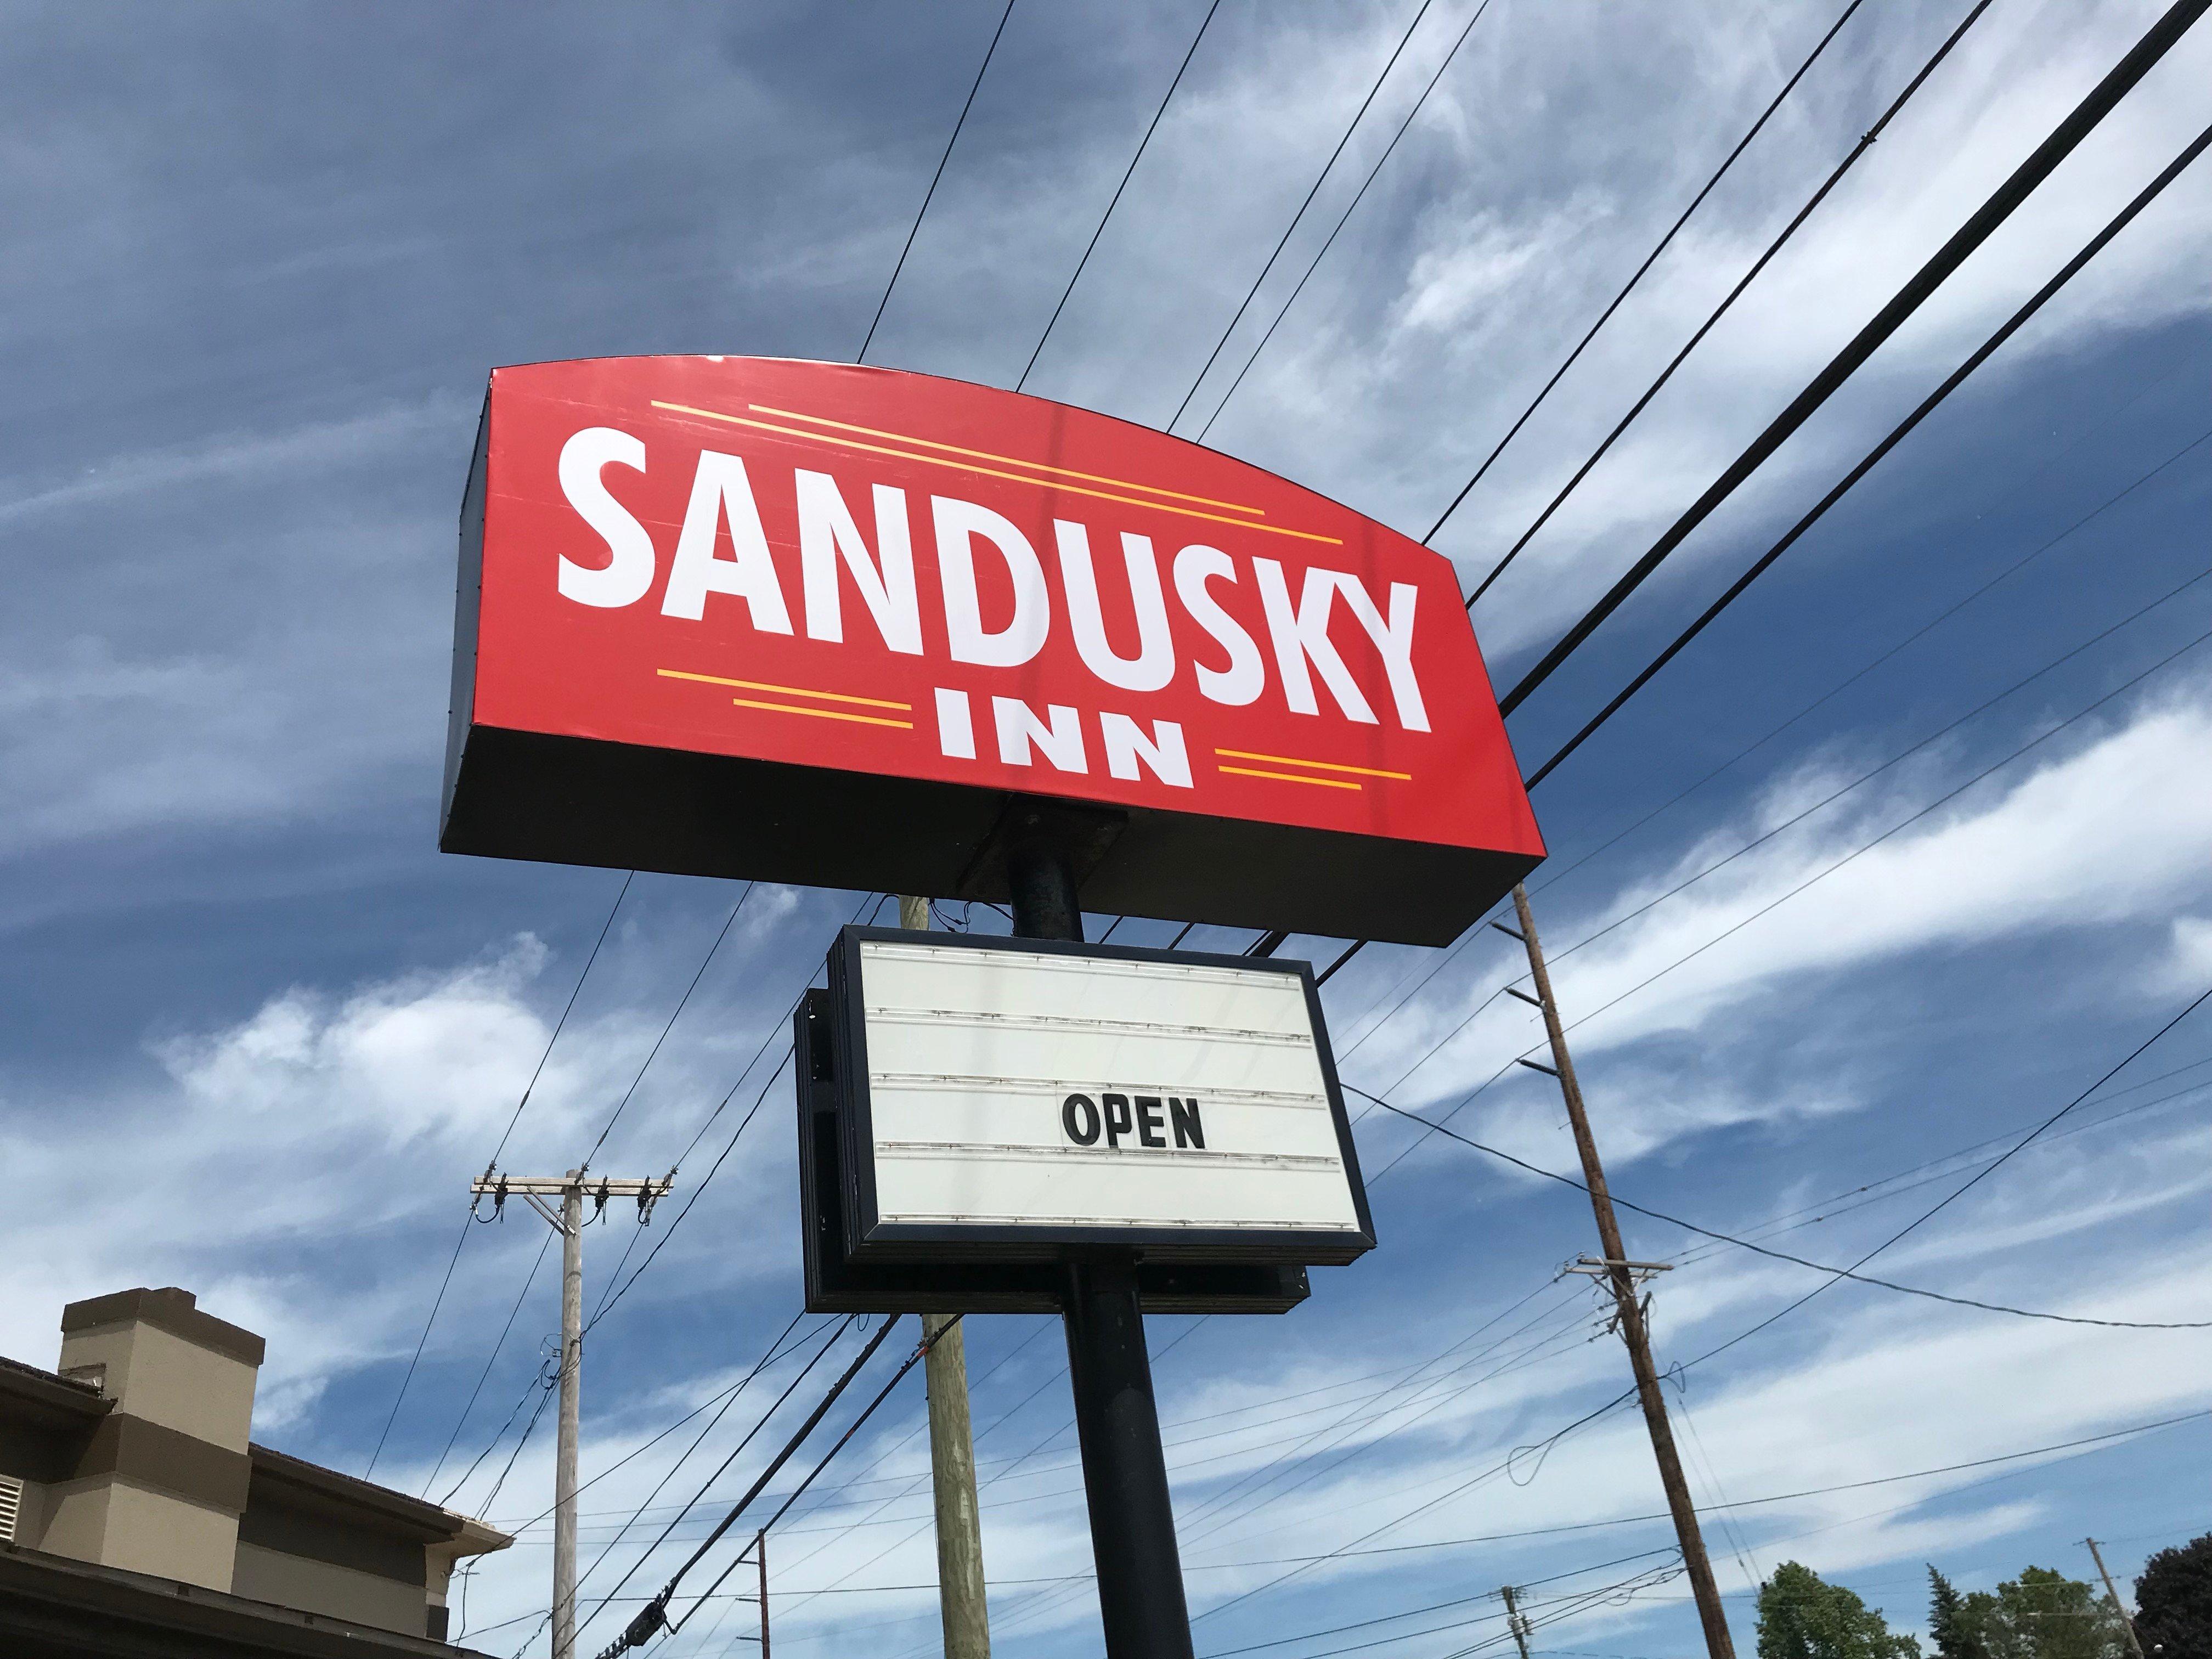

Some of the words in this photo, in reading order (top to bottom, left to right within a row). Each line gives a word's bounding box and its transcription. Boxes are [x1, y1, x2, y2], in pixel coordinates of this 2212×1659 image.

[557, 426, 1432, 733] SANDUSKY
[934, 687, 1195, 789] INN
[1062, 1092, 1206, 1149] OPEN
